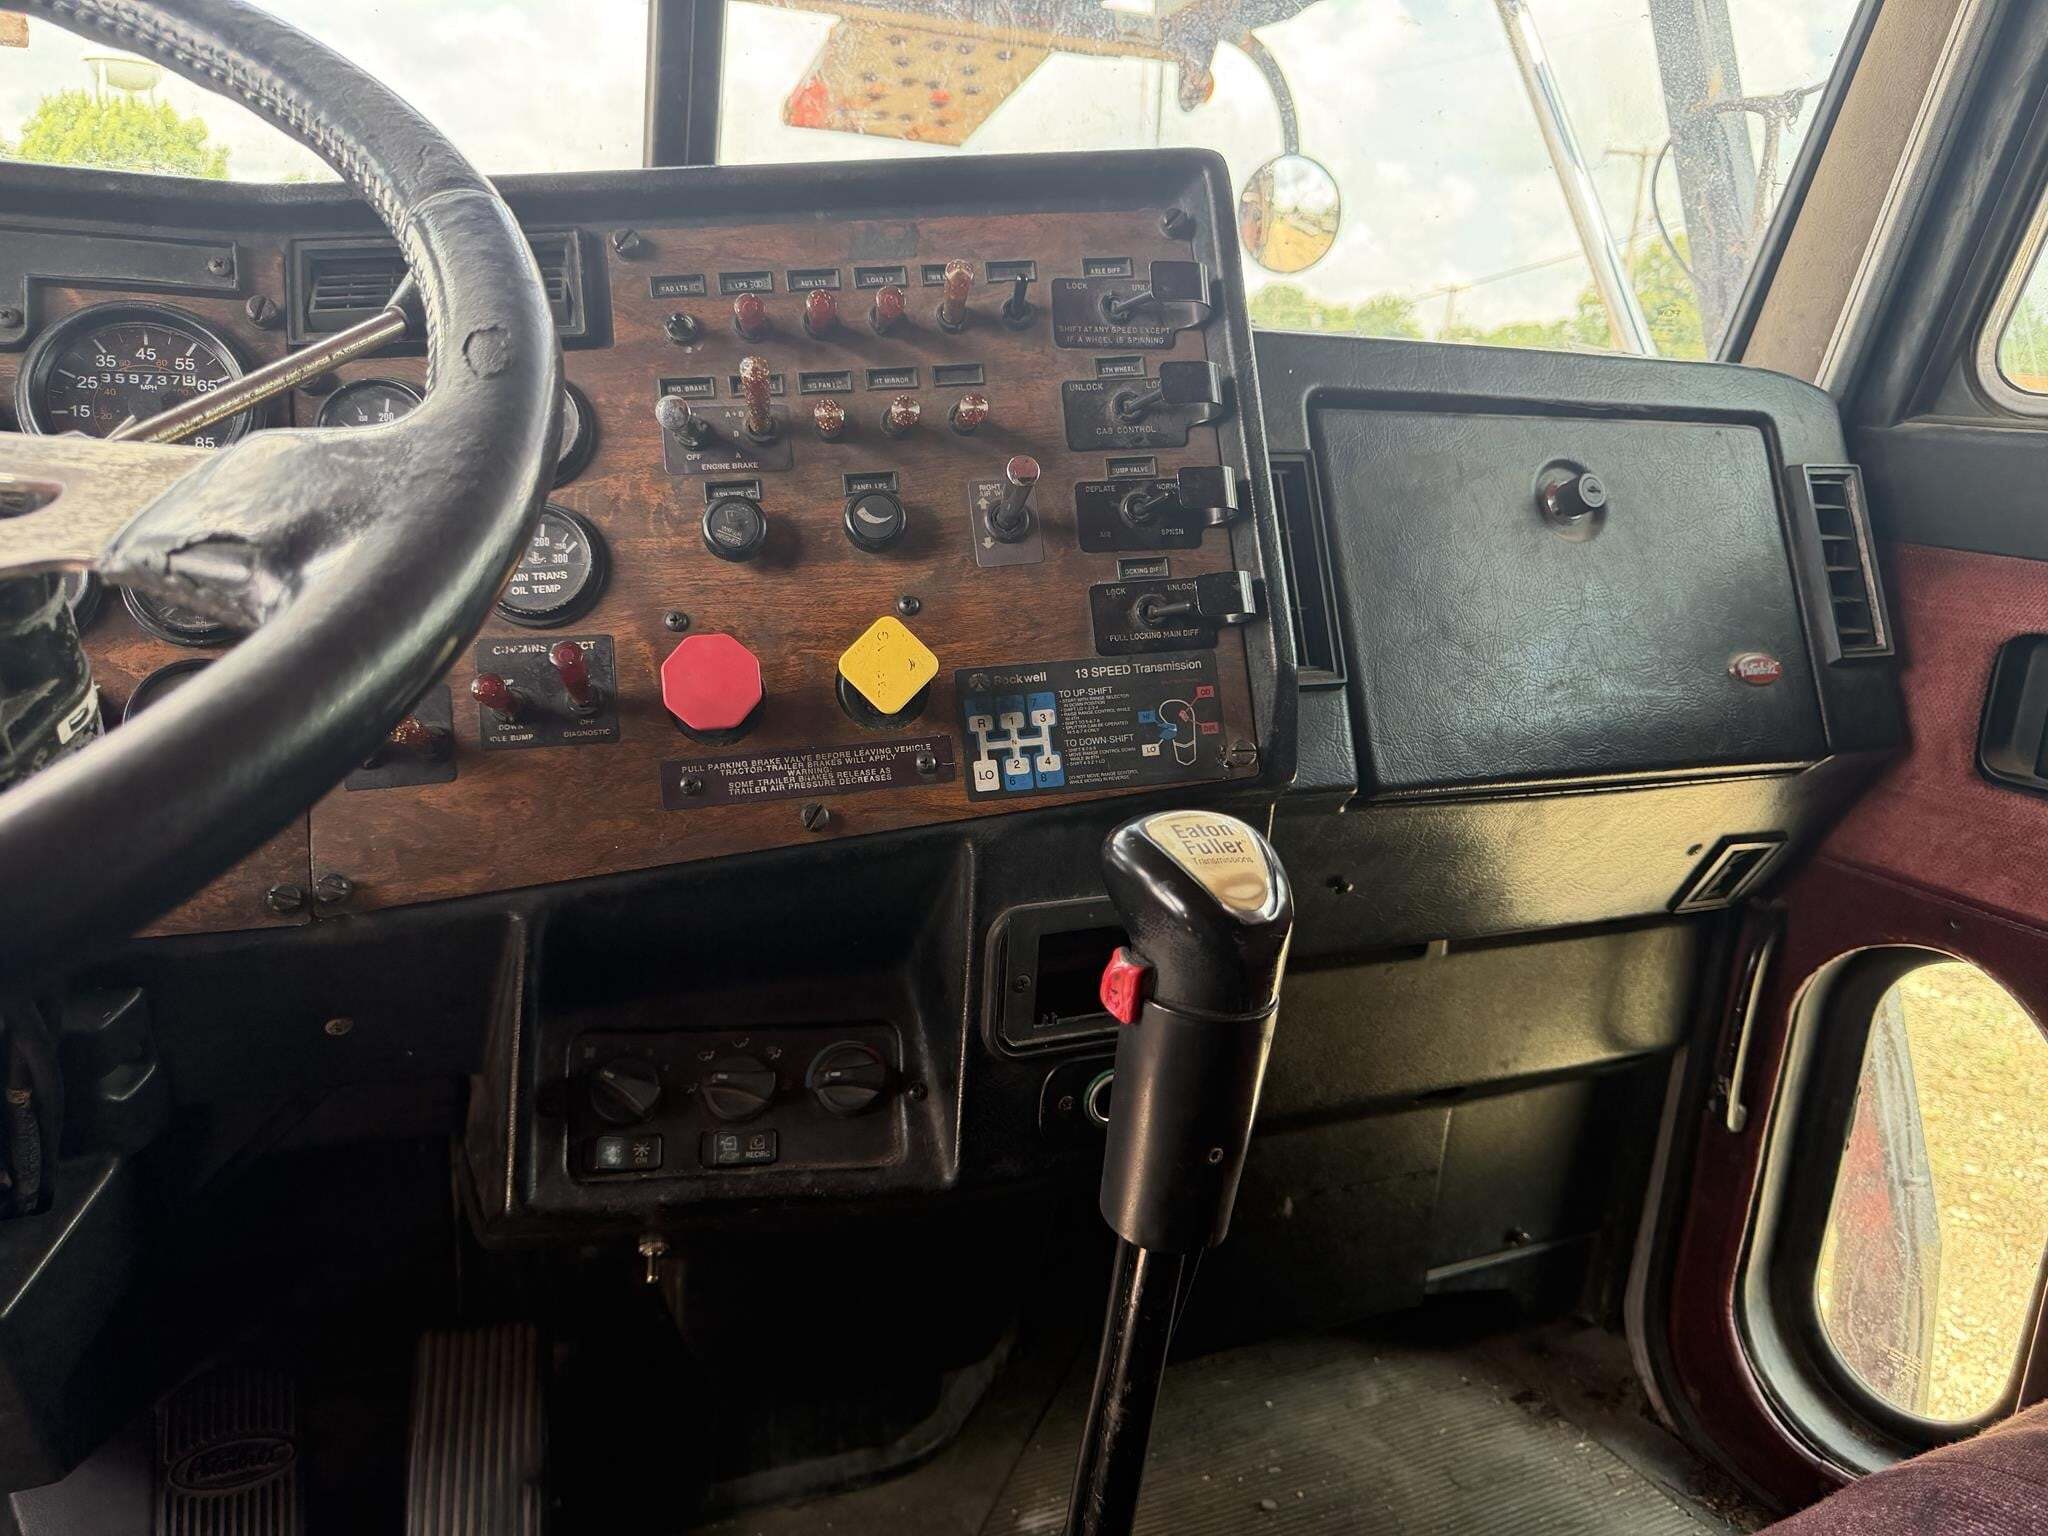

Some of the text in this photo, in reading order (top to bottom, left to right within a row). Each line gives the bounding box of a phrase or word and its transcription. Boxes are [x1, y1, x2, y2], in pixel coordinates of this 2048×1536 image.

[1066, 282, 1089, 291] LOCK
[1131, 283, 1151, 292] UNL
[1094, 324, 1111, 334] ANY
[1111, 325, 1138, 335] SPEED
[1140, 325, 1170, 334] EXCEPT
[1086, 336, 1112, 344] WHEEL
[1127, 336, 1164, 345] SPINNING
[136, 348, 157, 361] 45
[95, 355, 117, 367] 35
[175, 357, 195, 371] 55
[1114, 366, 1136, 374] WHEEL
[76, 376, 98, 389] 25
[197, 379, 217, 392] 65
[1069, 382, 1105, 392] UNLOCK
[71, 405, 91, 418] 15
[378, 412, 394, 422] 200
[1118, 425, 1157, 435] CONTROL
[195, 437, 215, 449] 85
[686, 453, 702, 462] OFF
[701, 461, 759, 471] ENGINE BRAKE
[1085, 485, 1116, 494] DEFLATE
[534, 537, 550, 547] 200
[553, 554, 569, 564] 300
[510, 571, 568, 582] AIN TRANS
[511, 584, 562, 596] OIL TEMP
[1106, 588, 1126, 597] LOCK
[1109, 629, 1200, 642] FULL LOCKING MAIN DIFF
[1075, 660, 1202, 679] 13 SPEED Transmission
[994, 672, 1047, 686] Rockwell
[1059, 687, 1113, 699] TO UP-SHIFT
[1009, 717, 1015, 726] 1
[1039, 713, 1047, 723] 3
[977, 719, 986, 729] R
[490, 734, 534, 743] IDLE BUMP
[563, 728, 612, 739] DIAGNOSTIC
[1065, 734, 1134, 748] TO DOWN-SHIFT
[1146, 745, 1157, 753] LO
[681, 743, 932, 774] PULL PARKING BRAKE VALVE BEFORE LEAVING VEHICLE
[1044, 756, 1051, 765] 4
[719, 753, 897, 777] TRACTOR-TRAILER BRAKES WILL APPLY
[1013, 760, 1021, 769] 2
[728, 767, 891, 790] SOME TRAILER BRAKES RELEASE AS
[979, 770, 995, 781] LO
[1009, 775, 1016, 786] 6
[1041, 772, 1048, 782] 8
[728, 774, 892, 796] TRAILER AIR PRESSURE DECREASES
[1171, 823, 1234, 839] Eaton
[1182, 839, 1245, 855] Fuller
[1192, 856, 1254, 866] Transmissions
